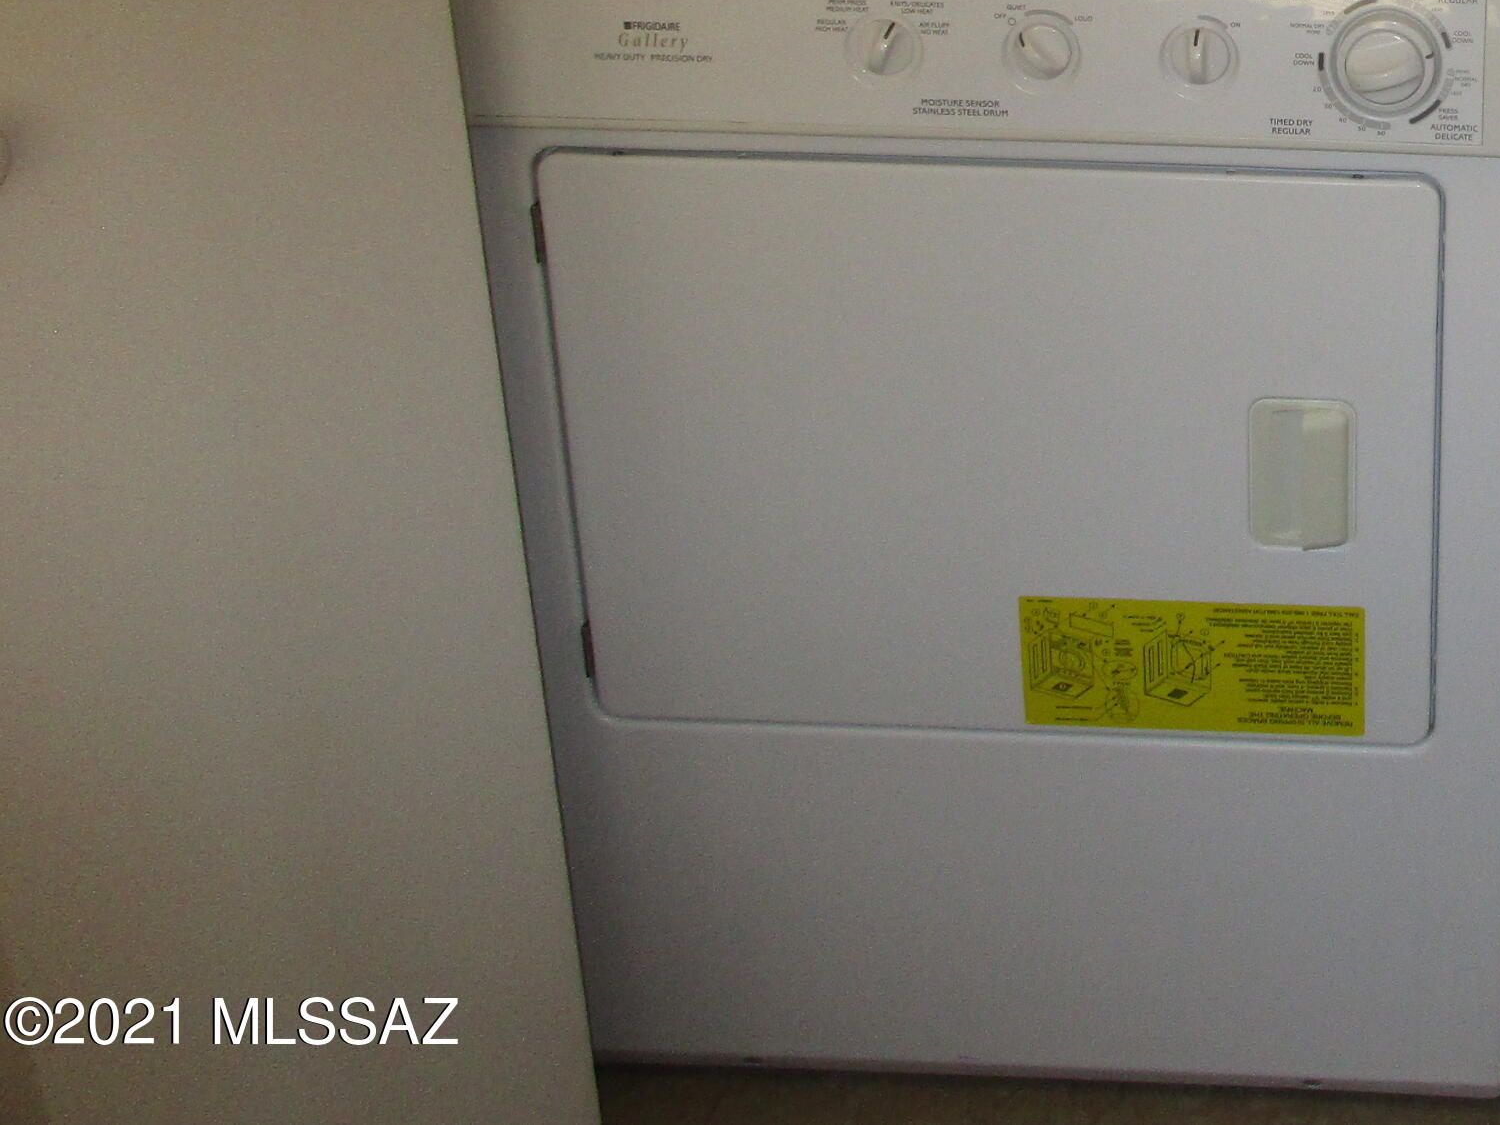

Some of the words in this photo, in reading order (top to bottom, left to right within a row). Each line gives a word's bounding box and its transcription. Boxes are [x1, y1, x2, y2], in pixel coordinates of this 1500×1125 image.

[632, 21, 681, 31] FRIGIDAIRE
[618, 32, 689, 53] Gallery
[920, 98, 964, 108] MOISTURE
[965, 100, 1001, 109] SENSOR
[912, 107, 956, 117] STAINLESS
[957, 108, 982, 117] STEEL
[983, 109, 1010, 118] DRUM
[1269, 118, 1295, 126] TIMED
[1296, 119, 1313, 127] DRY
[1271, 127, 1312, 136] REGULAR
[1430, 123, 1479, 133] AUTOMATIC
[1434, 132, 1474, 141] DELICATE
